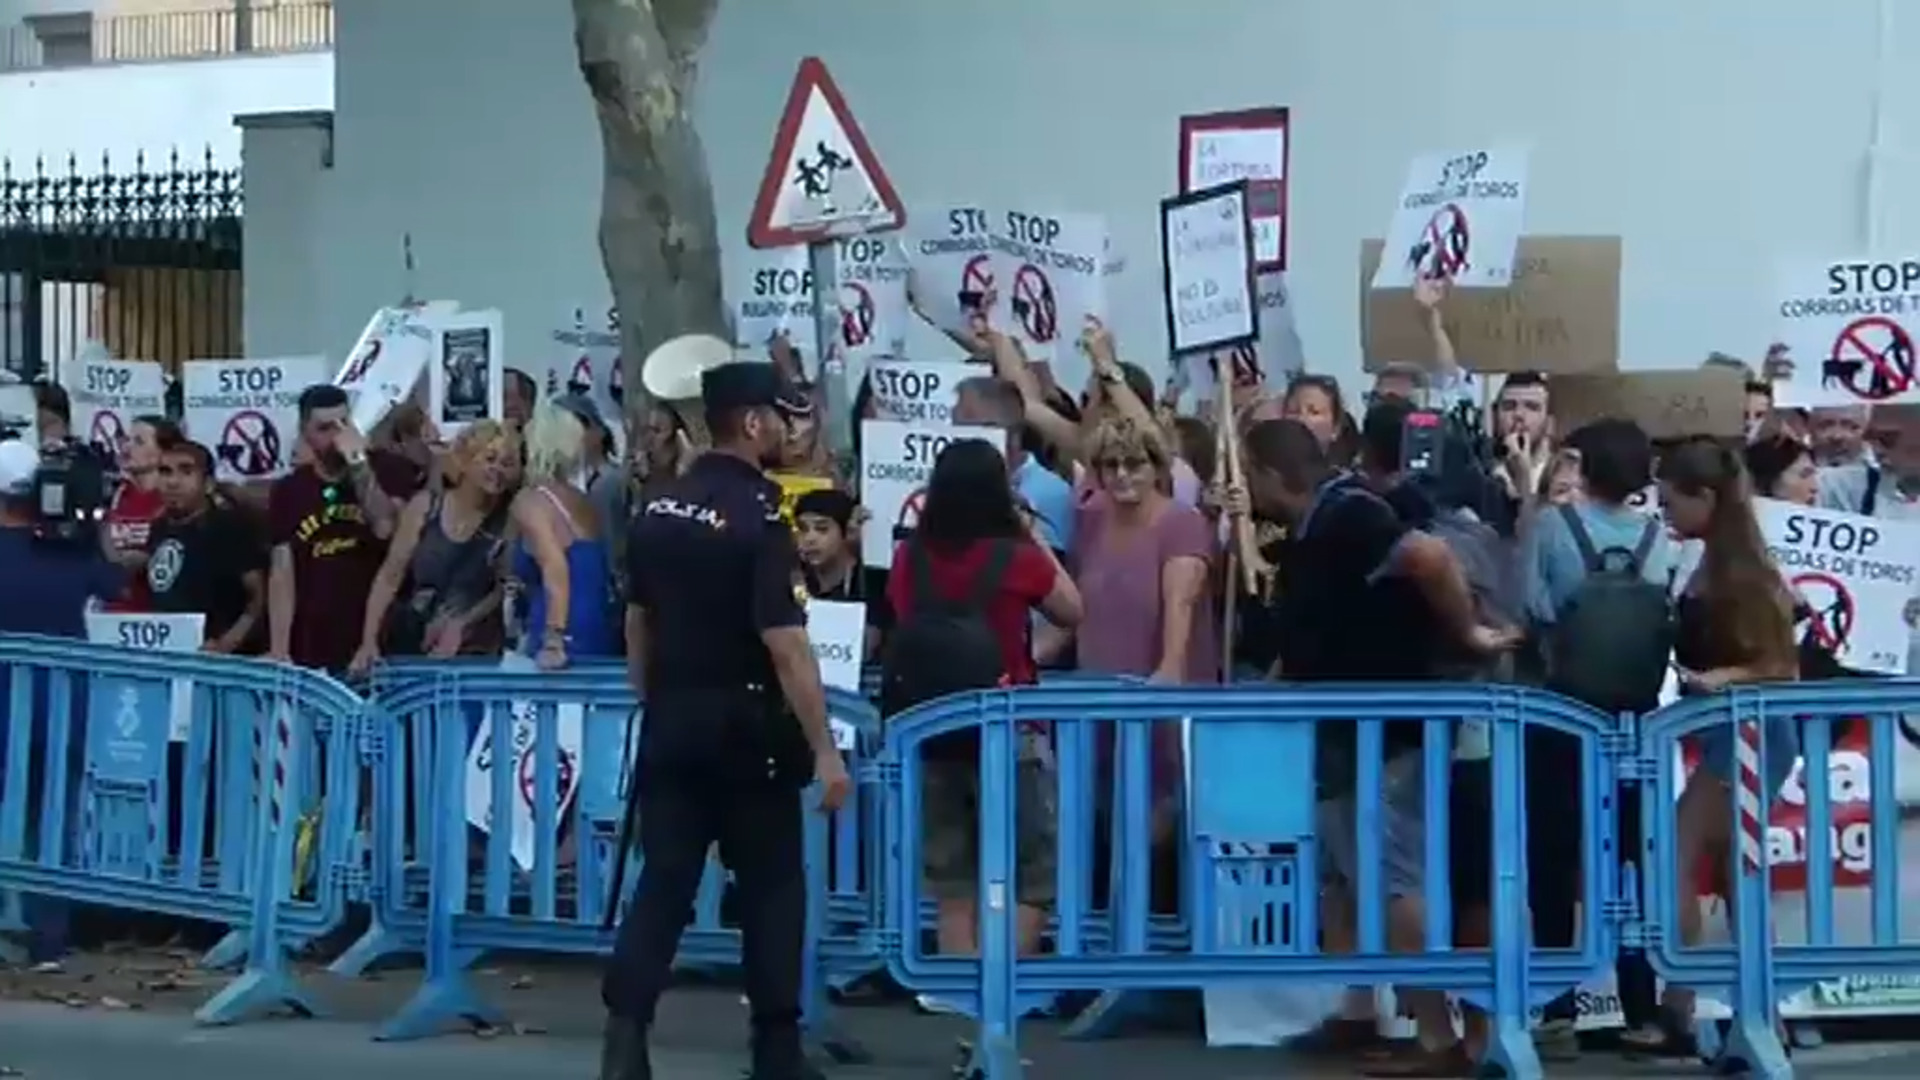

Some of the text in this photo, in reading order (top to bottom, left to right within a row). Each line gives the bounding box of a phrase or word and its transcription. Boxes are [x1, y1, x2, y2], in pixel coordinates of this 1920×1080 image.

[1438, 151, 1488, 186] STOP
[1006, 211, 1060, 246] STOP
[841, 240, 885, 263] TOP
[1828, 261, 1920, 295] STOP
[1779, 297, 1876, 317] CORRIDAS
[1879, 295, 1904, 314] DE
[86, 365, 129, 392] STOP
[218, 367, 282, 392] STOP
[875, 368, 940, 400] STOP
[903, 433, 948, 464] STO
[1784, 515, 1880, 555] STOP
[1859, 560, 1915, 586] TOROS
[118, 621, 171, 646] STOP
